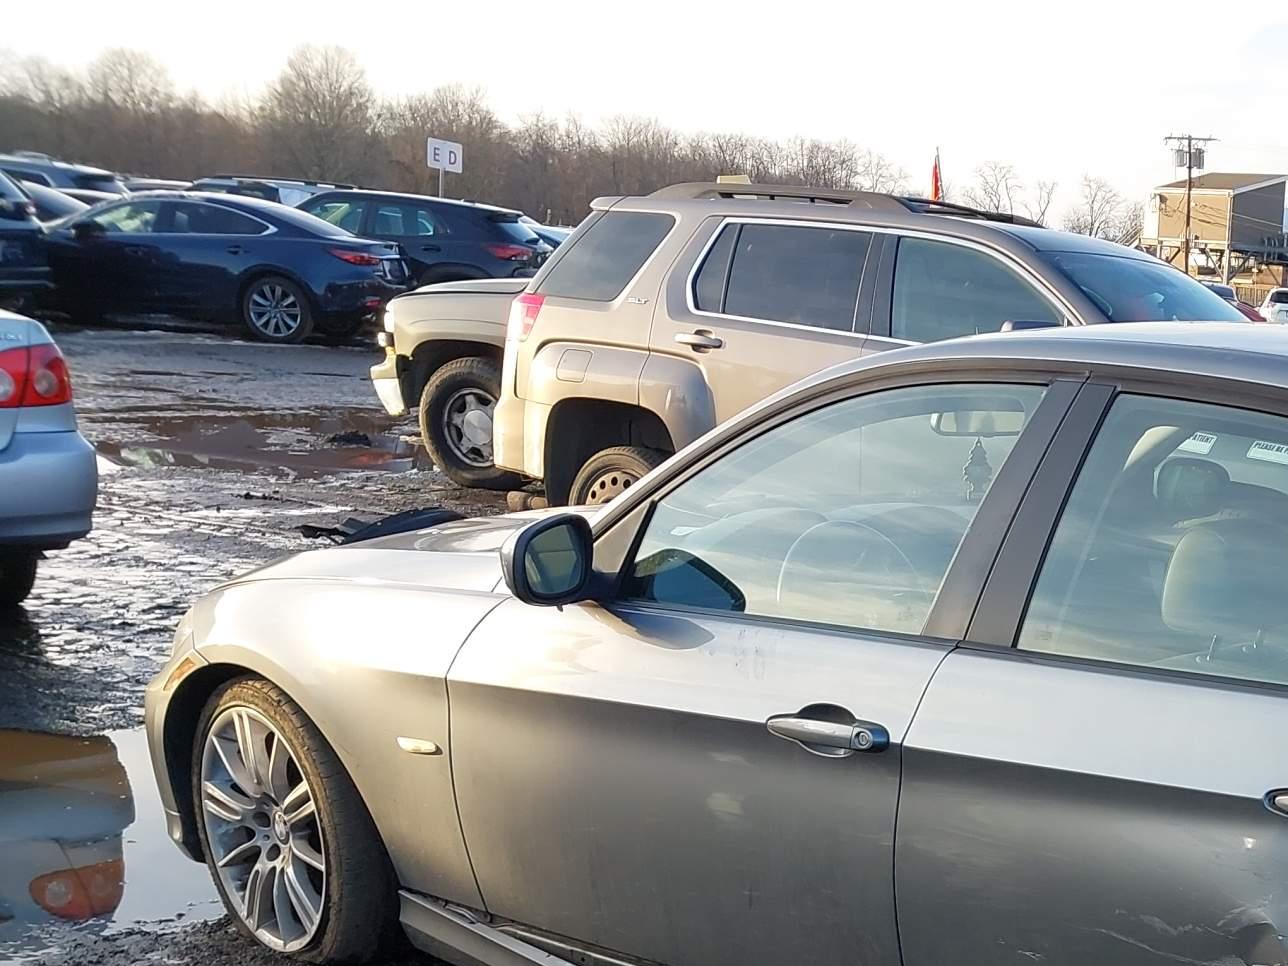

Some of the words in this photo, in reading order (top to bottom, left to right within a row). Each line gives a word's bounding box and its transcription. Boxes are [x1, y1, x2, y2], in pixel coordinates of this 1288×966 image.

[433, 147, 440, 163] E
[448, 150, 457, 165] D
[1191, 433, 1215, 444] ATIENT
[1253, 442, 1276, 452] PLEASE
